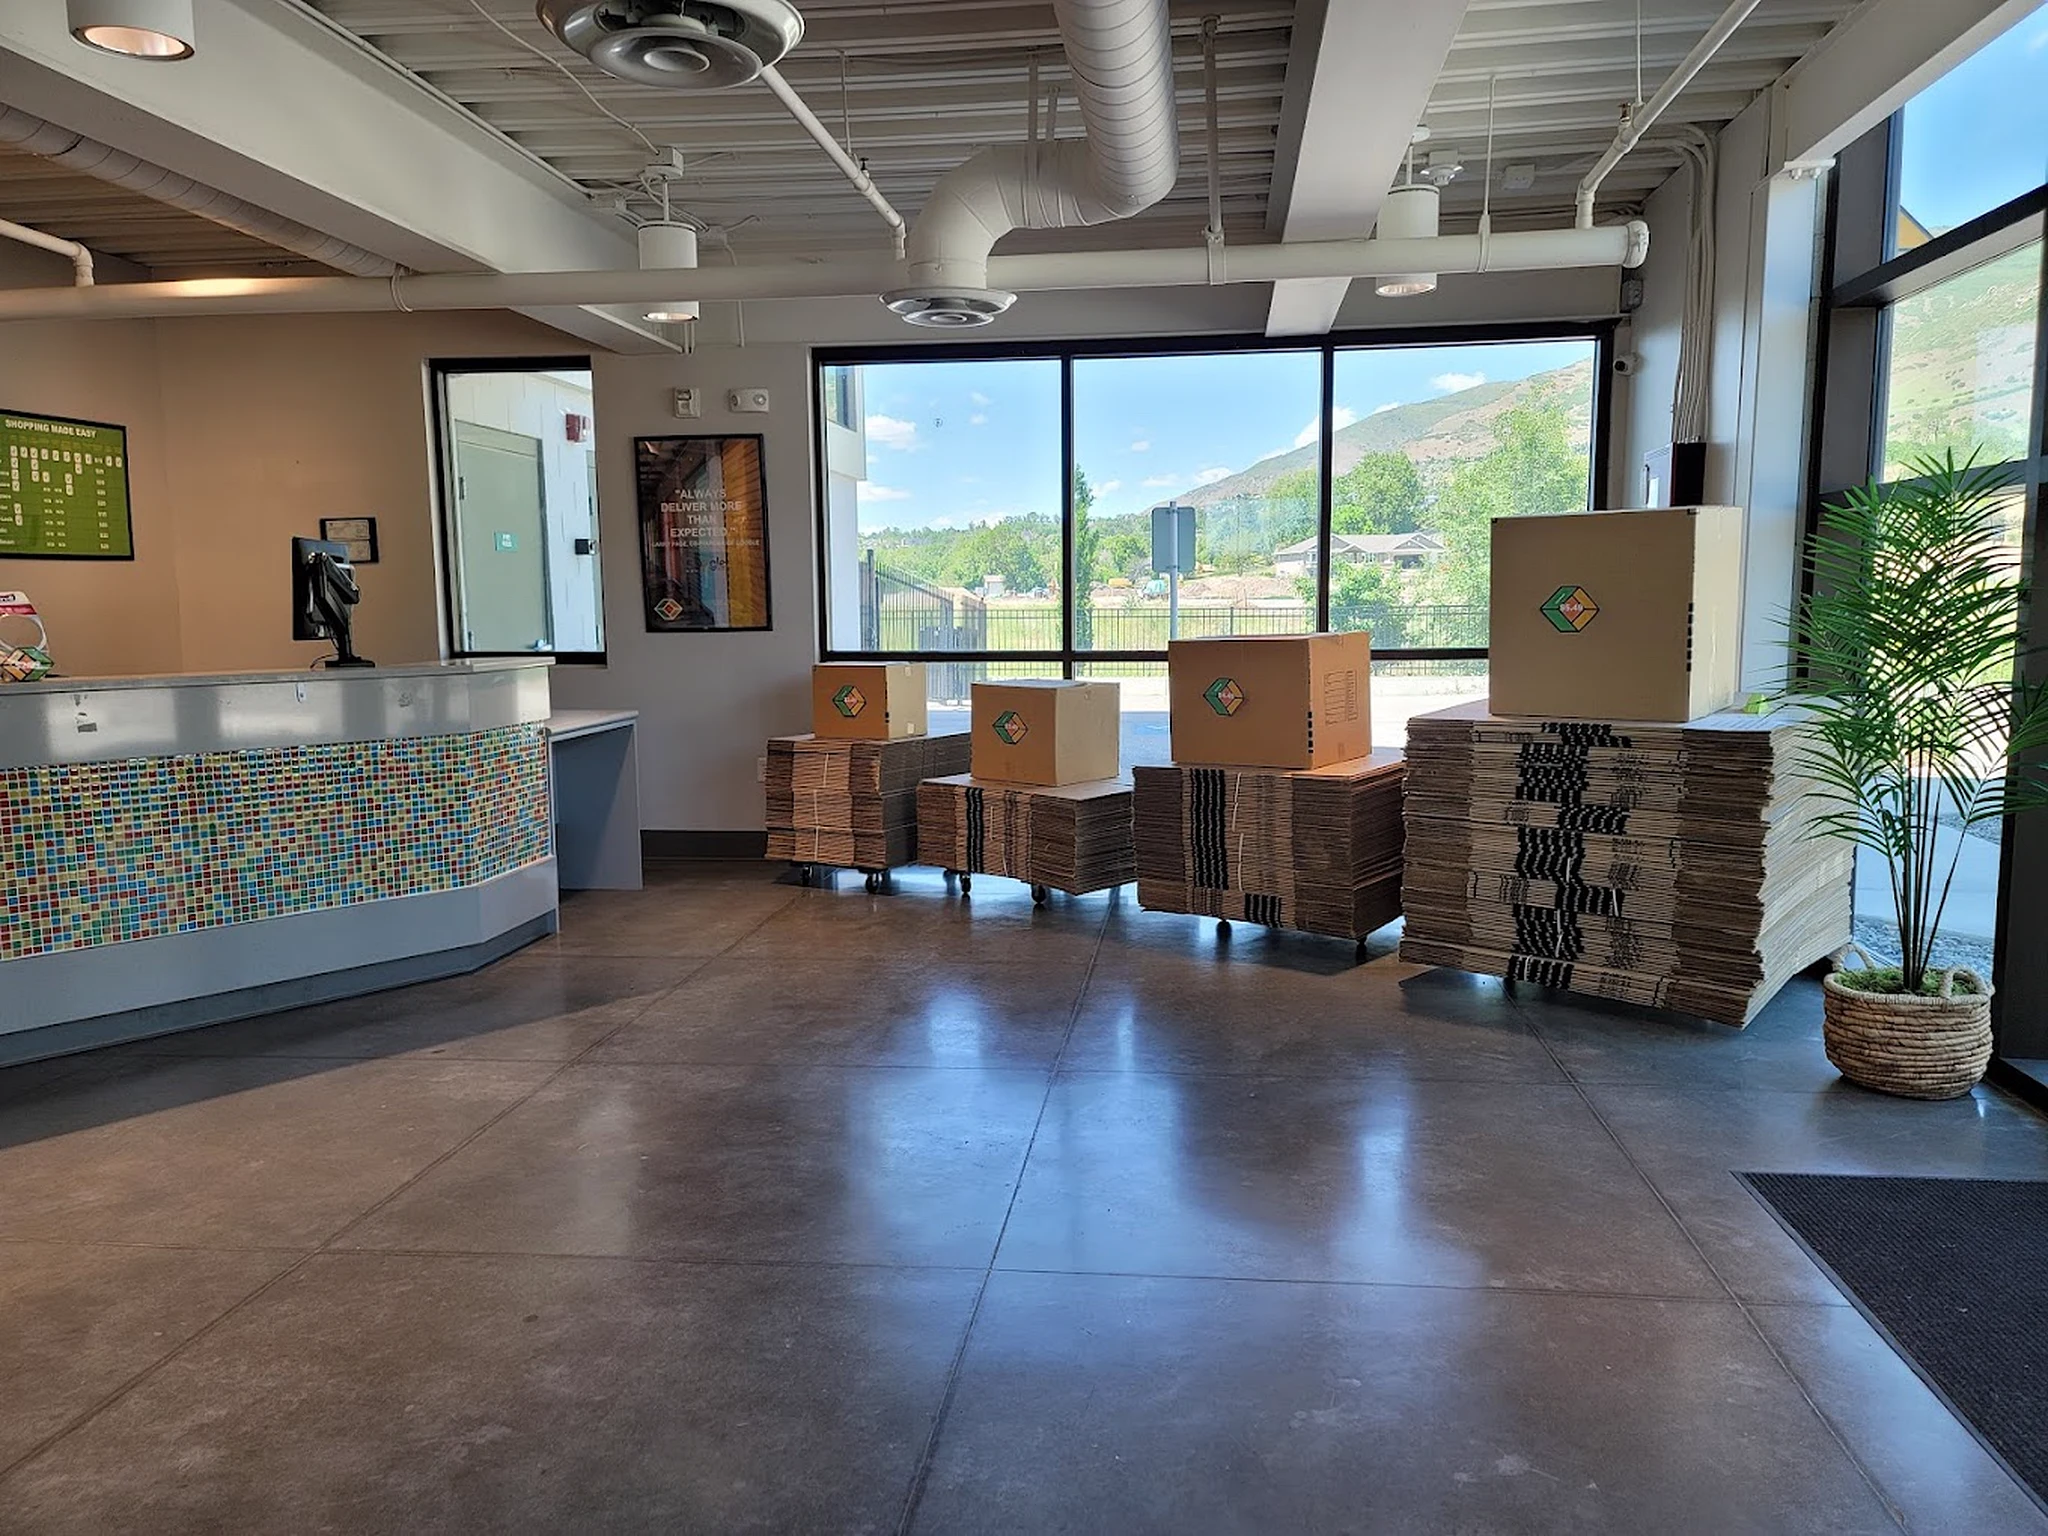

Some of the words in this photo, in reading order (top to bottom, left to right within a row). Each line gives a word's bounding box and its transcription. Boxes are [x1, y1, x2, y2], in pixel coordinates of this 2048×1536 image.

[5, 419, 50, 432] SHOPPING
[51, 424, 75, 435] MADE
[75, 428, 97, 438] EASY
[660, 502, 708, 512] DELIVER
[710, 501, 742, 511] MORE
[687, 515, 717, 525] THAN
